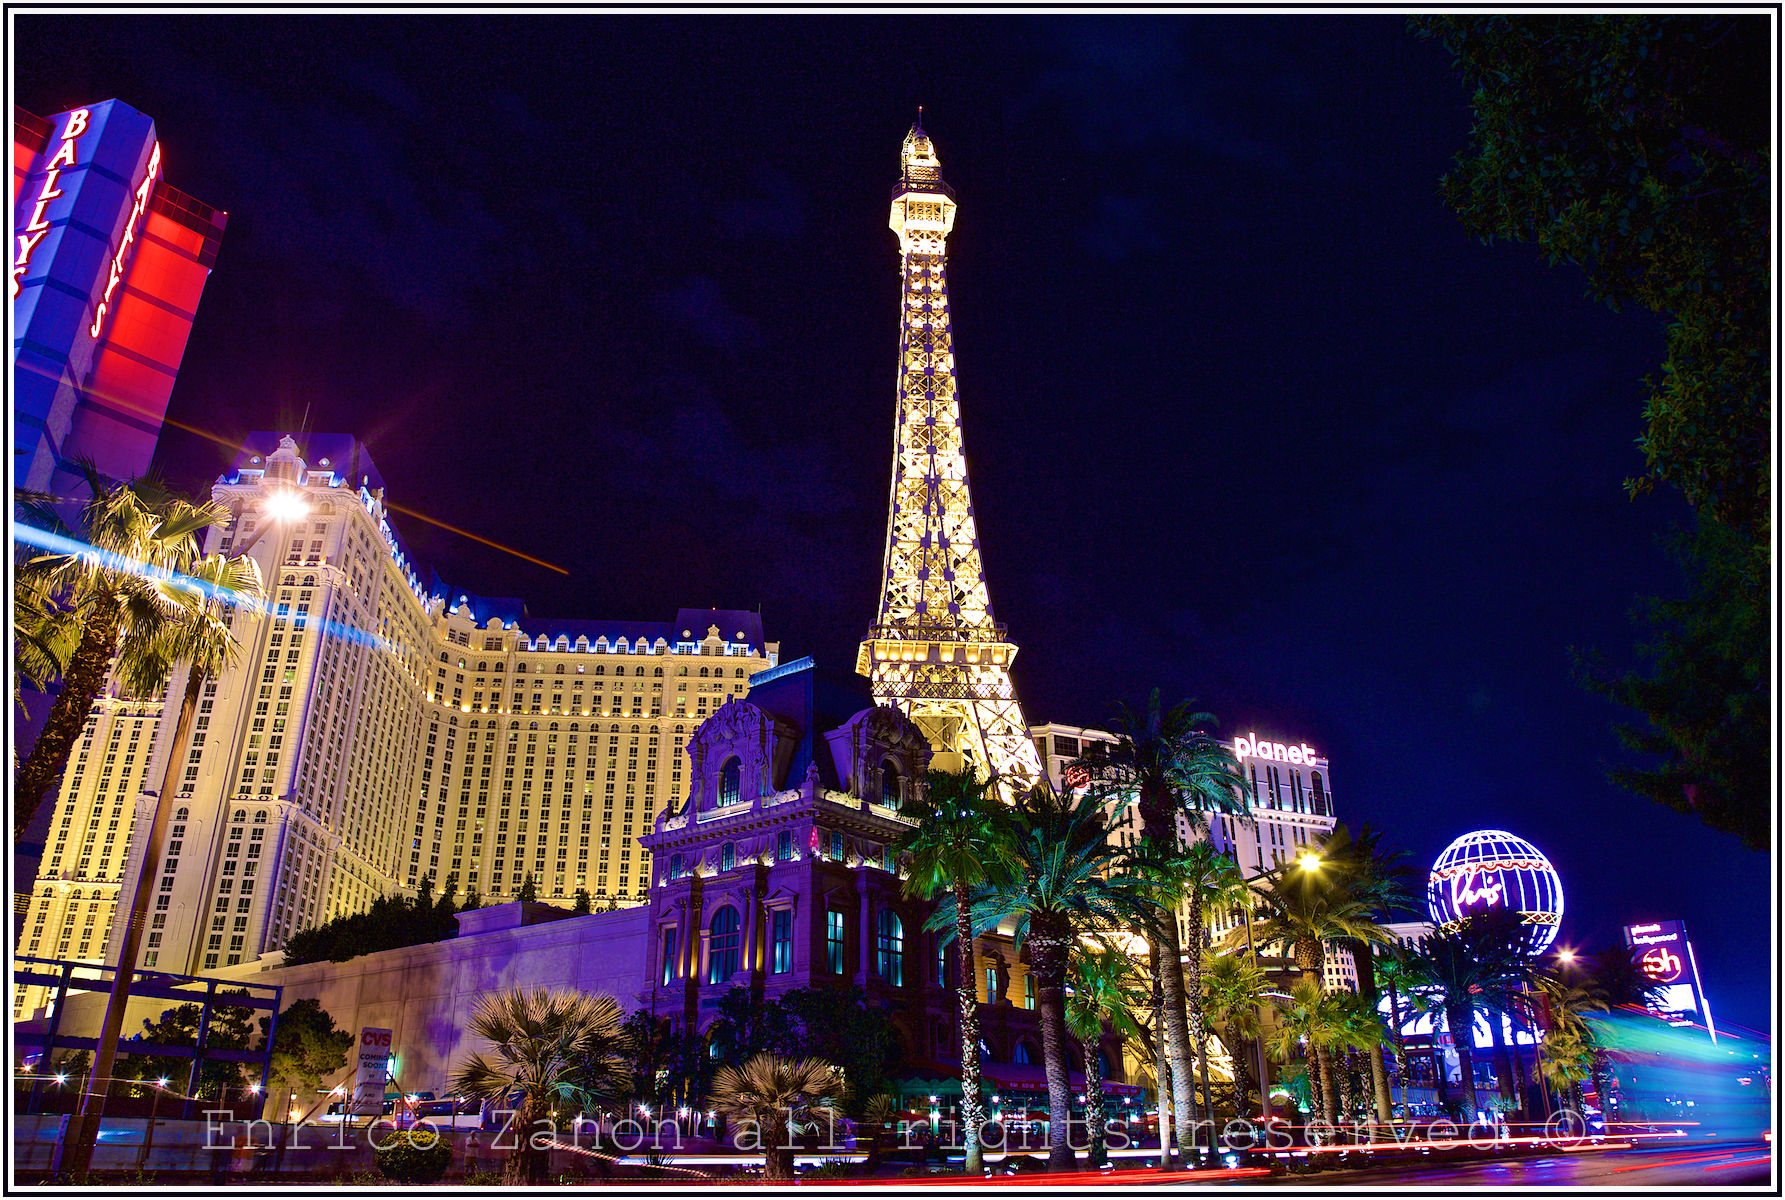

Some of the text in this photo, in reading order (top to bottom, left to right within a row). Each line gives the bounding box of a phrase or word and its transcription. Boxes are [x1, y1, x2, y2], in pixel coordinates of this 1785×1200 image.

[91, 140, 161, 338] BALLYS
[1233, 731, 1317, 768] planet
[363, 1032, 391, 1047] CVS
[360, 1053, 389, 1062] COMING
